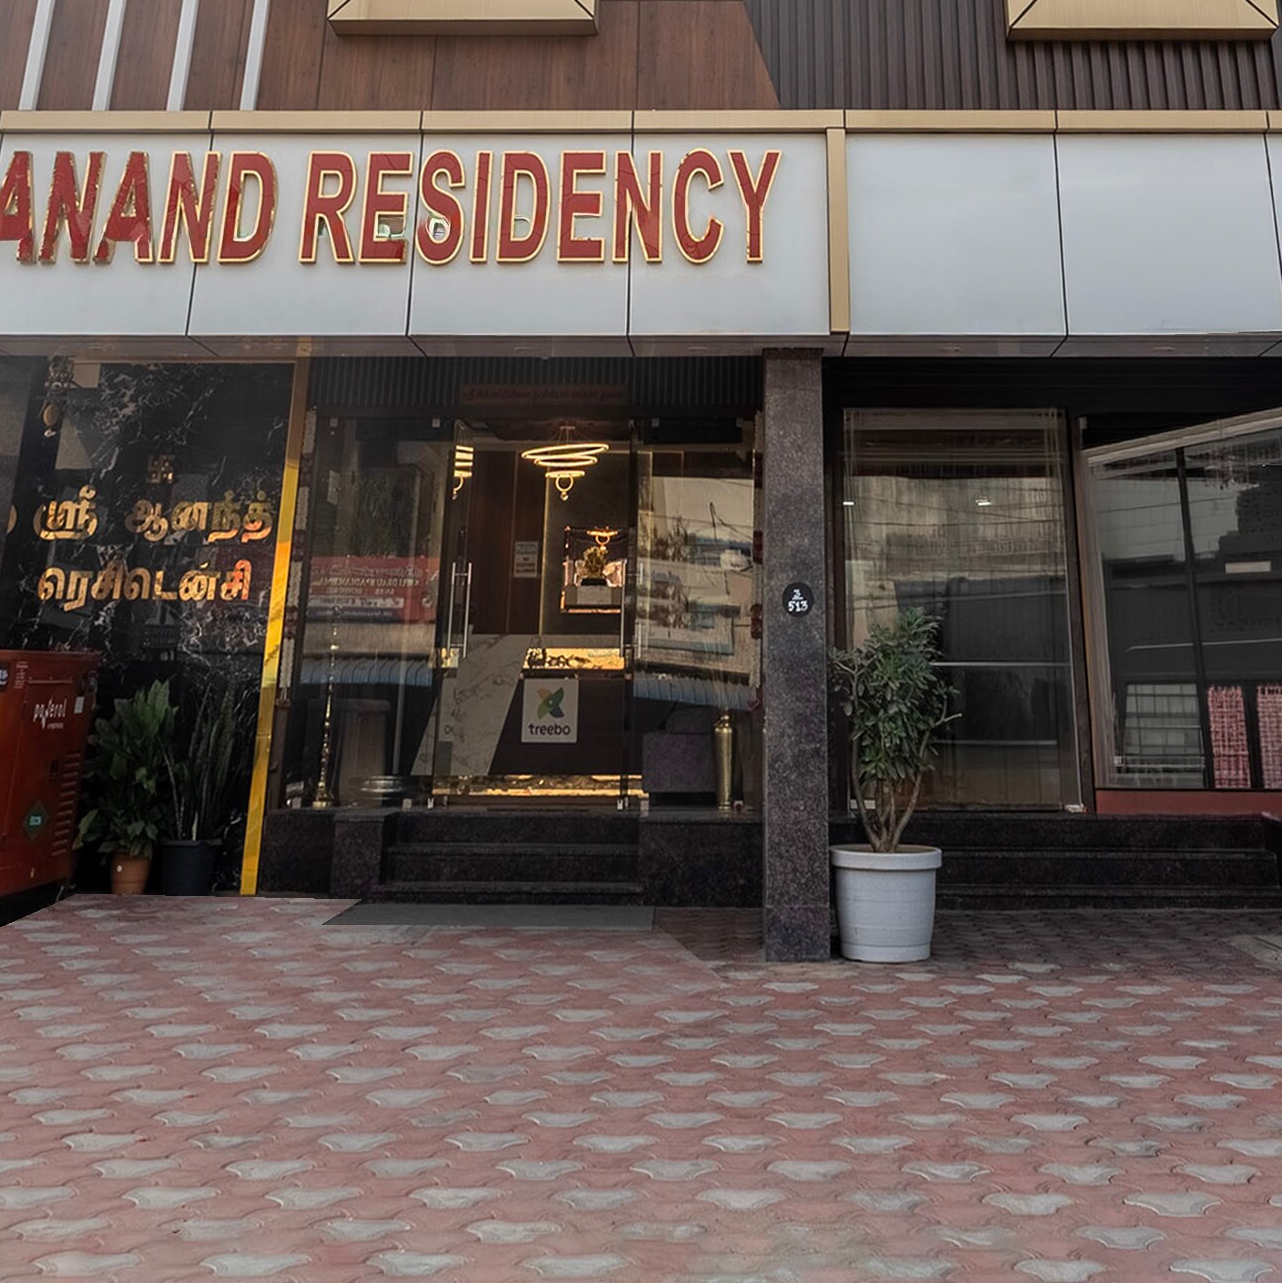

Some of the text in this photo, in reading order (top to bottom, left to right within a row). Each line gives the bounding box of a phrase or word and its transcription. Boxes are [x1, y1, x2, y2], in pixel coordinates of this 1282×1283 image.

[298, 148, 782, 265] RESIDENCY
[125, 489, 273, 543] ஆனந்த்
[788, 600, 808, 612] 513
[528, 723, 571, 736] treebo
